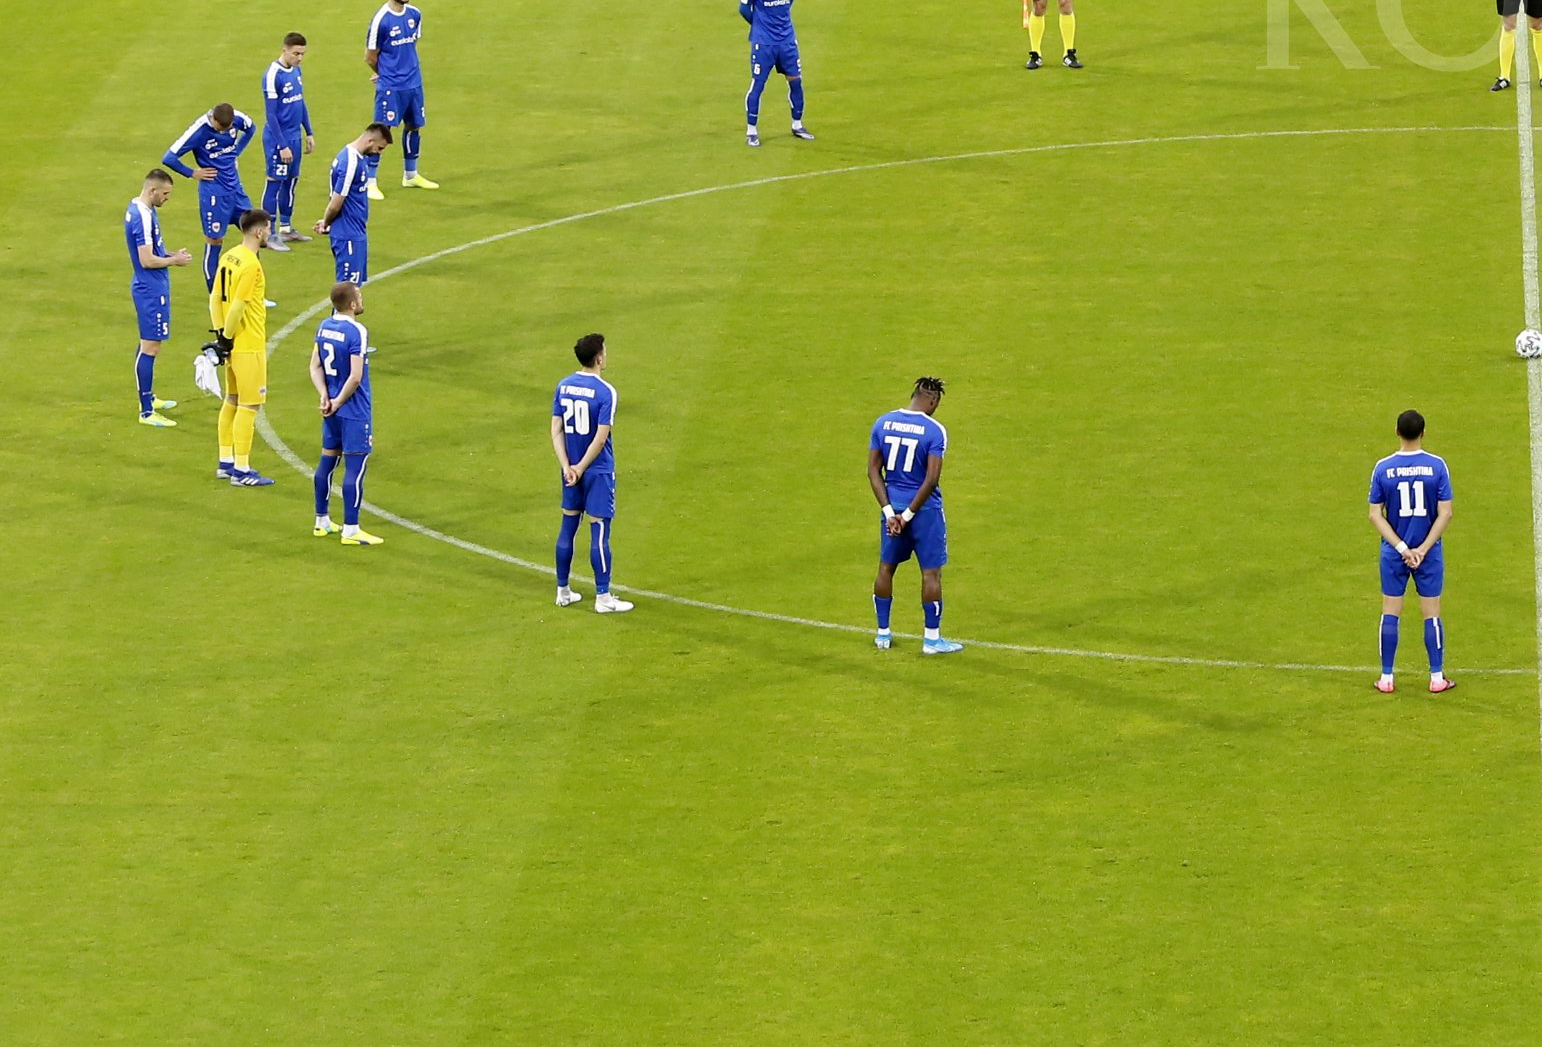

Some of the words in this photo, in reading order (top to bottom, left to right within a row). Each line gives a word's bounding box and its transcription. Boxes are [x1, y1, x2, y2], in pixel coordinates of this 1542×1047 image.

[753, 63, 761, 75] 6
[275, 163, 288, 176] 23
[349, 271, 360, 284] 21
[161, 322, 169, 335] 5
[323, 342, 338, 377] 2
[560, 398, 590, 436] 20
[883, 421, 891, 431] FC
[891, 422, 926, 436] PRISHTINA
[884, 435, 919, 472] 77
[1386, 468, 1396, 479] FC
[1396, 466, 1434, 478] PRISHTINA
[1396, 481, 1427, 517] 11
